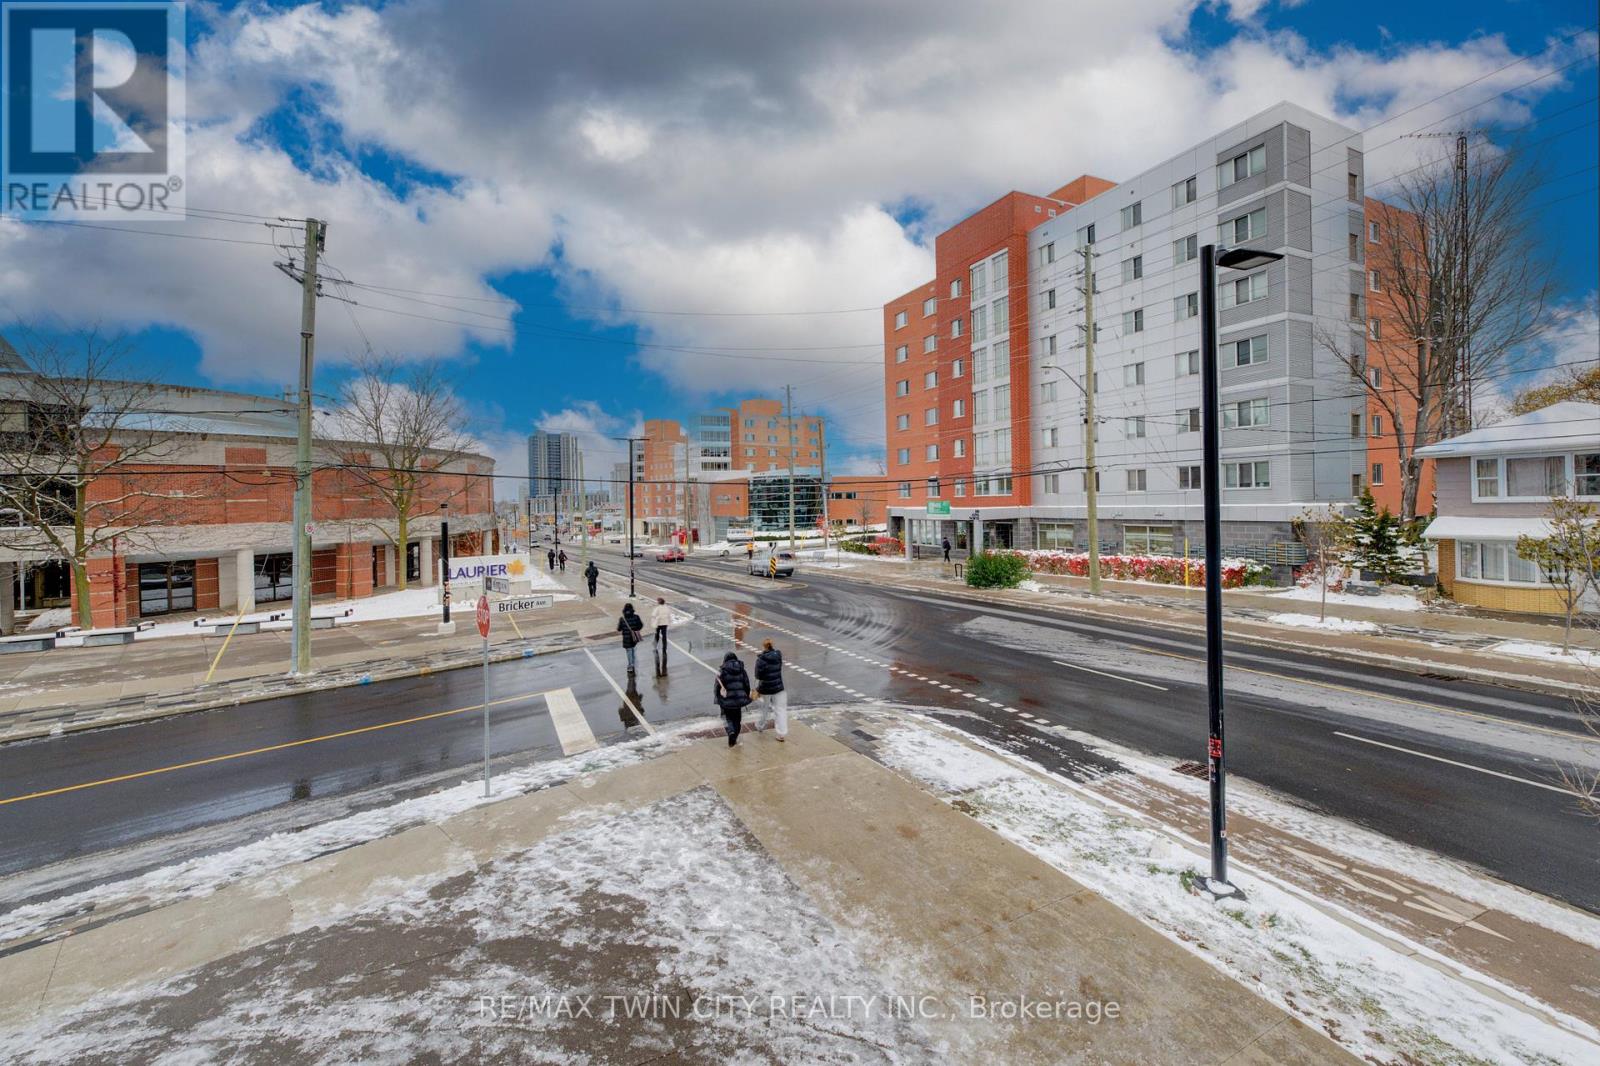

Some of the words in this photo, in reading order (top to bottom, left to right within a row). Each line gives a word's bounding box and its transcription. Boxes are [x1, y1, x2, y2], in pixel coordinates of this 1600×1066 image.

[448, 564, 507, 580] LAURIER
[498, 600, 535, 613] Bricker
[477, 608, 490, 625] STOP
